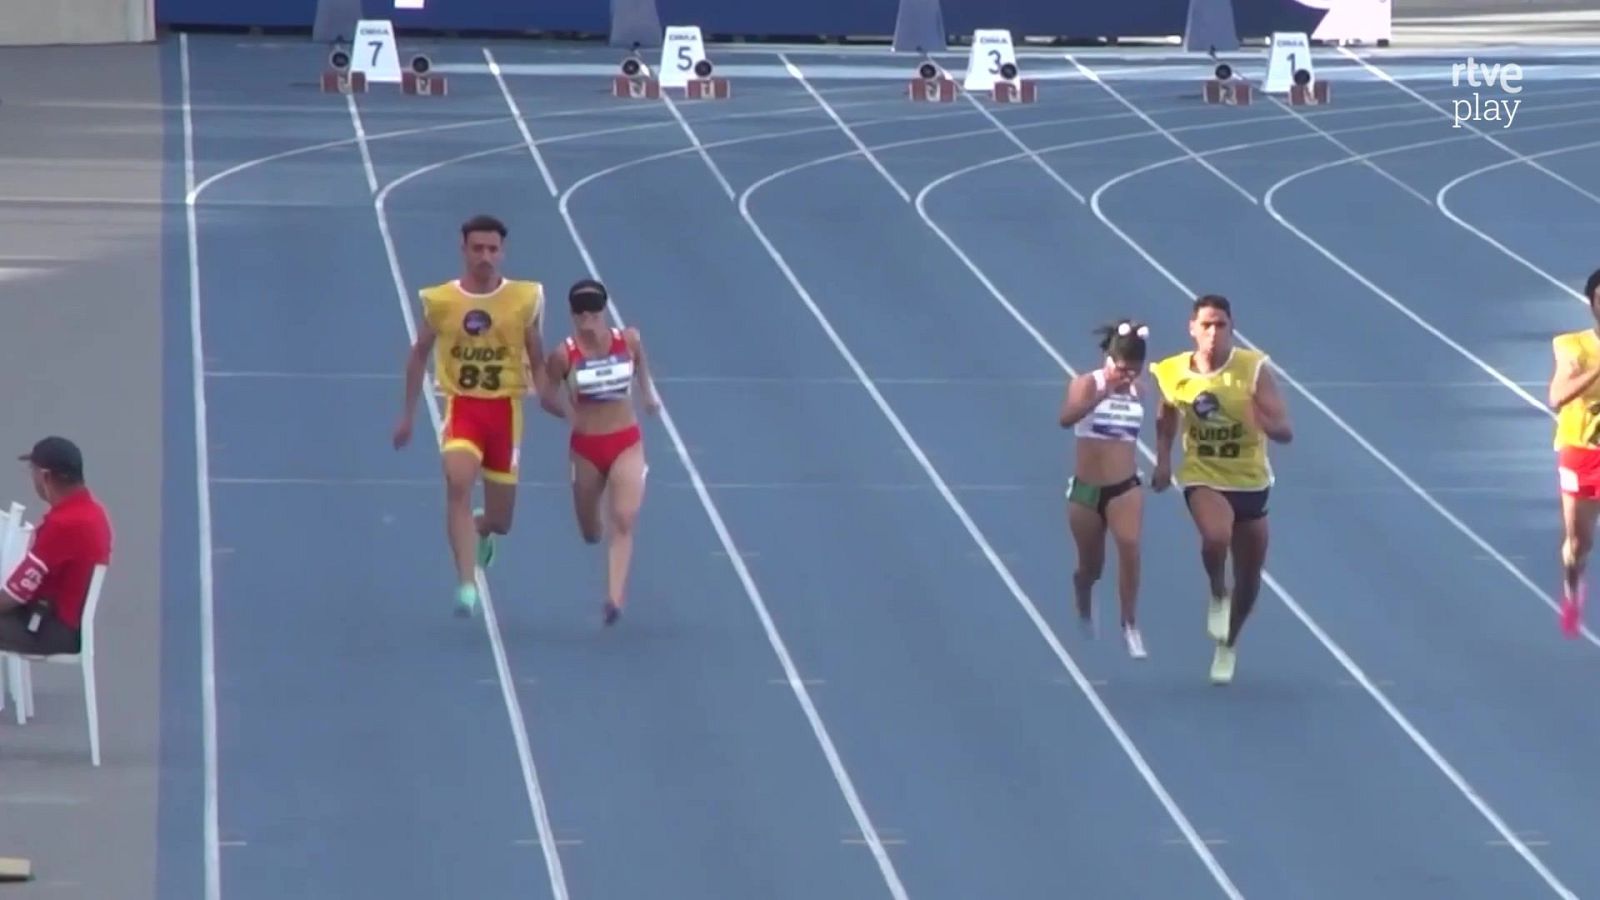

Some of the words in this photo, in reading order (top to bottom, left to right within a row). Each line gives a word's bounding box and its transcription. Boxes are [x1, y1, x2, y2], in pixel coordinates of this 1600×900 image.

[368, 40, 383, 68] 7
[676, 46, 693, 71] 5
[987, 49, 1002, 75] 3
[1286, 53, 1297, 76] 1
[450, 345, 508, 362] GUIDE
[457, 364, 504, 391] 83
